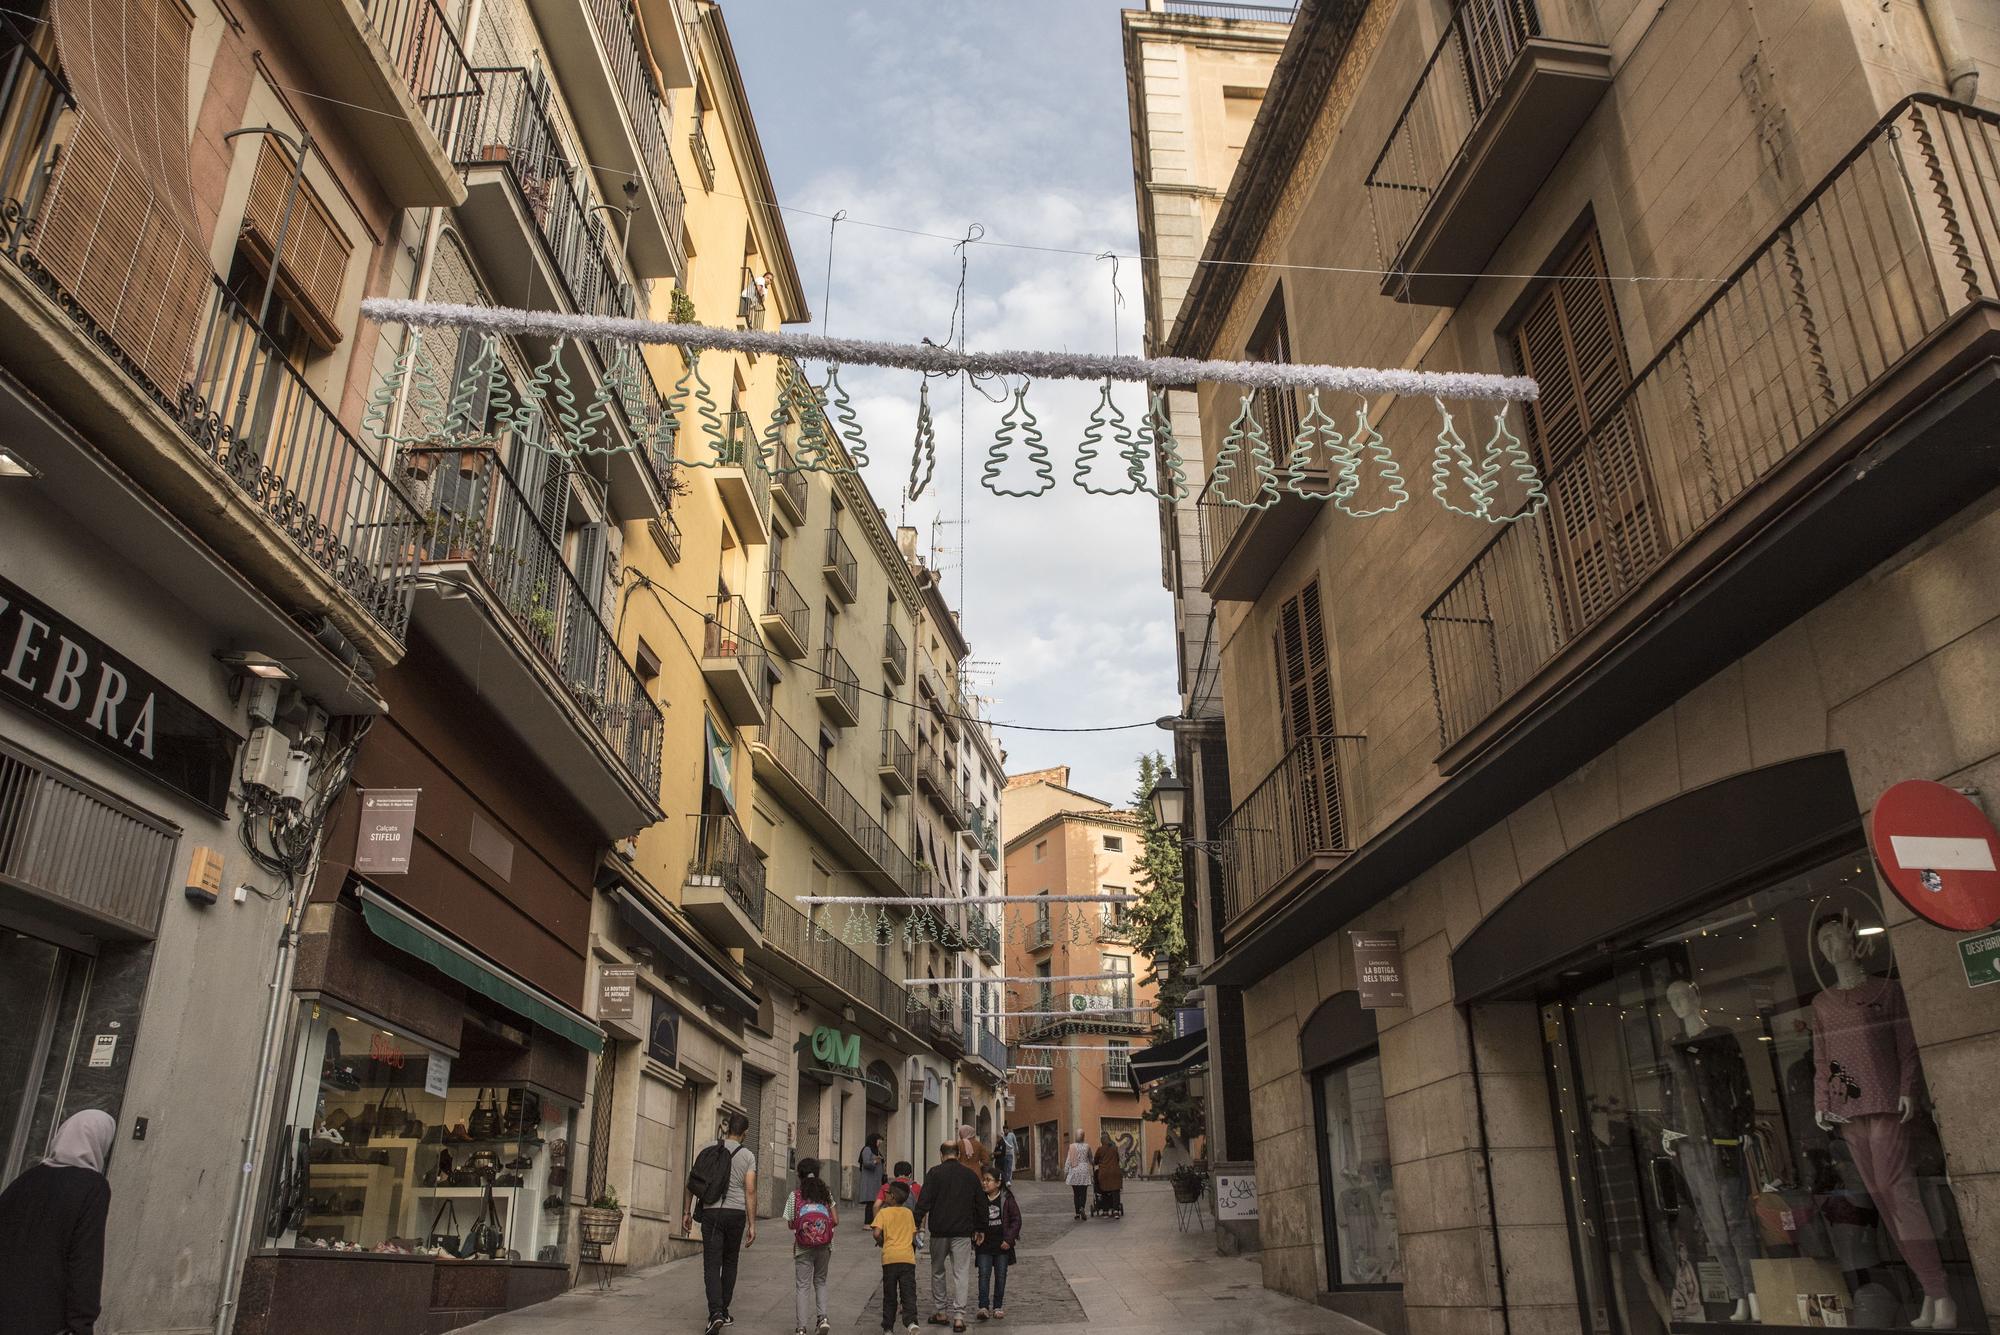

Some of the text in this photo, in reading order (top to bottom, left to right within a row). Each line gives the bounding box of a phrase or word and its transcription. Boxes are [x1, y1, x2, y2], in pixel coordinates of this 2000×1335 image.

[0, 597, 154, 760] EBRA
[375, 825, 398, 833] Calçats
[370, 833, 401, 842] STIFELIO
[1364, 966, 1395, 975] LA BOTIGA
[1363, 975, 1378, 983] DELS
